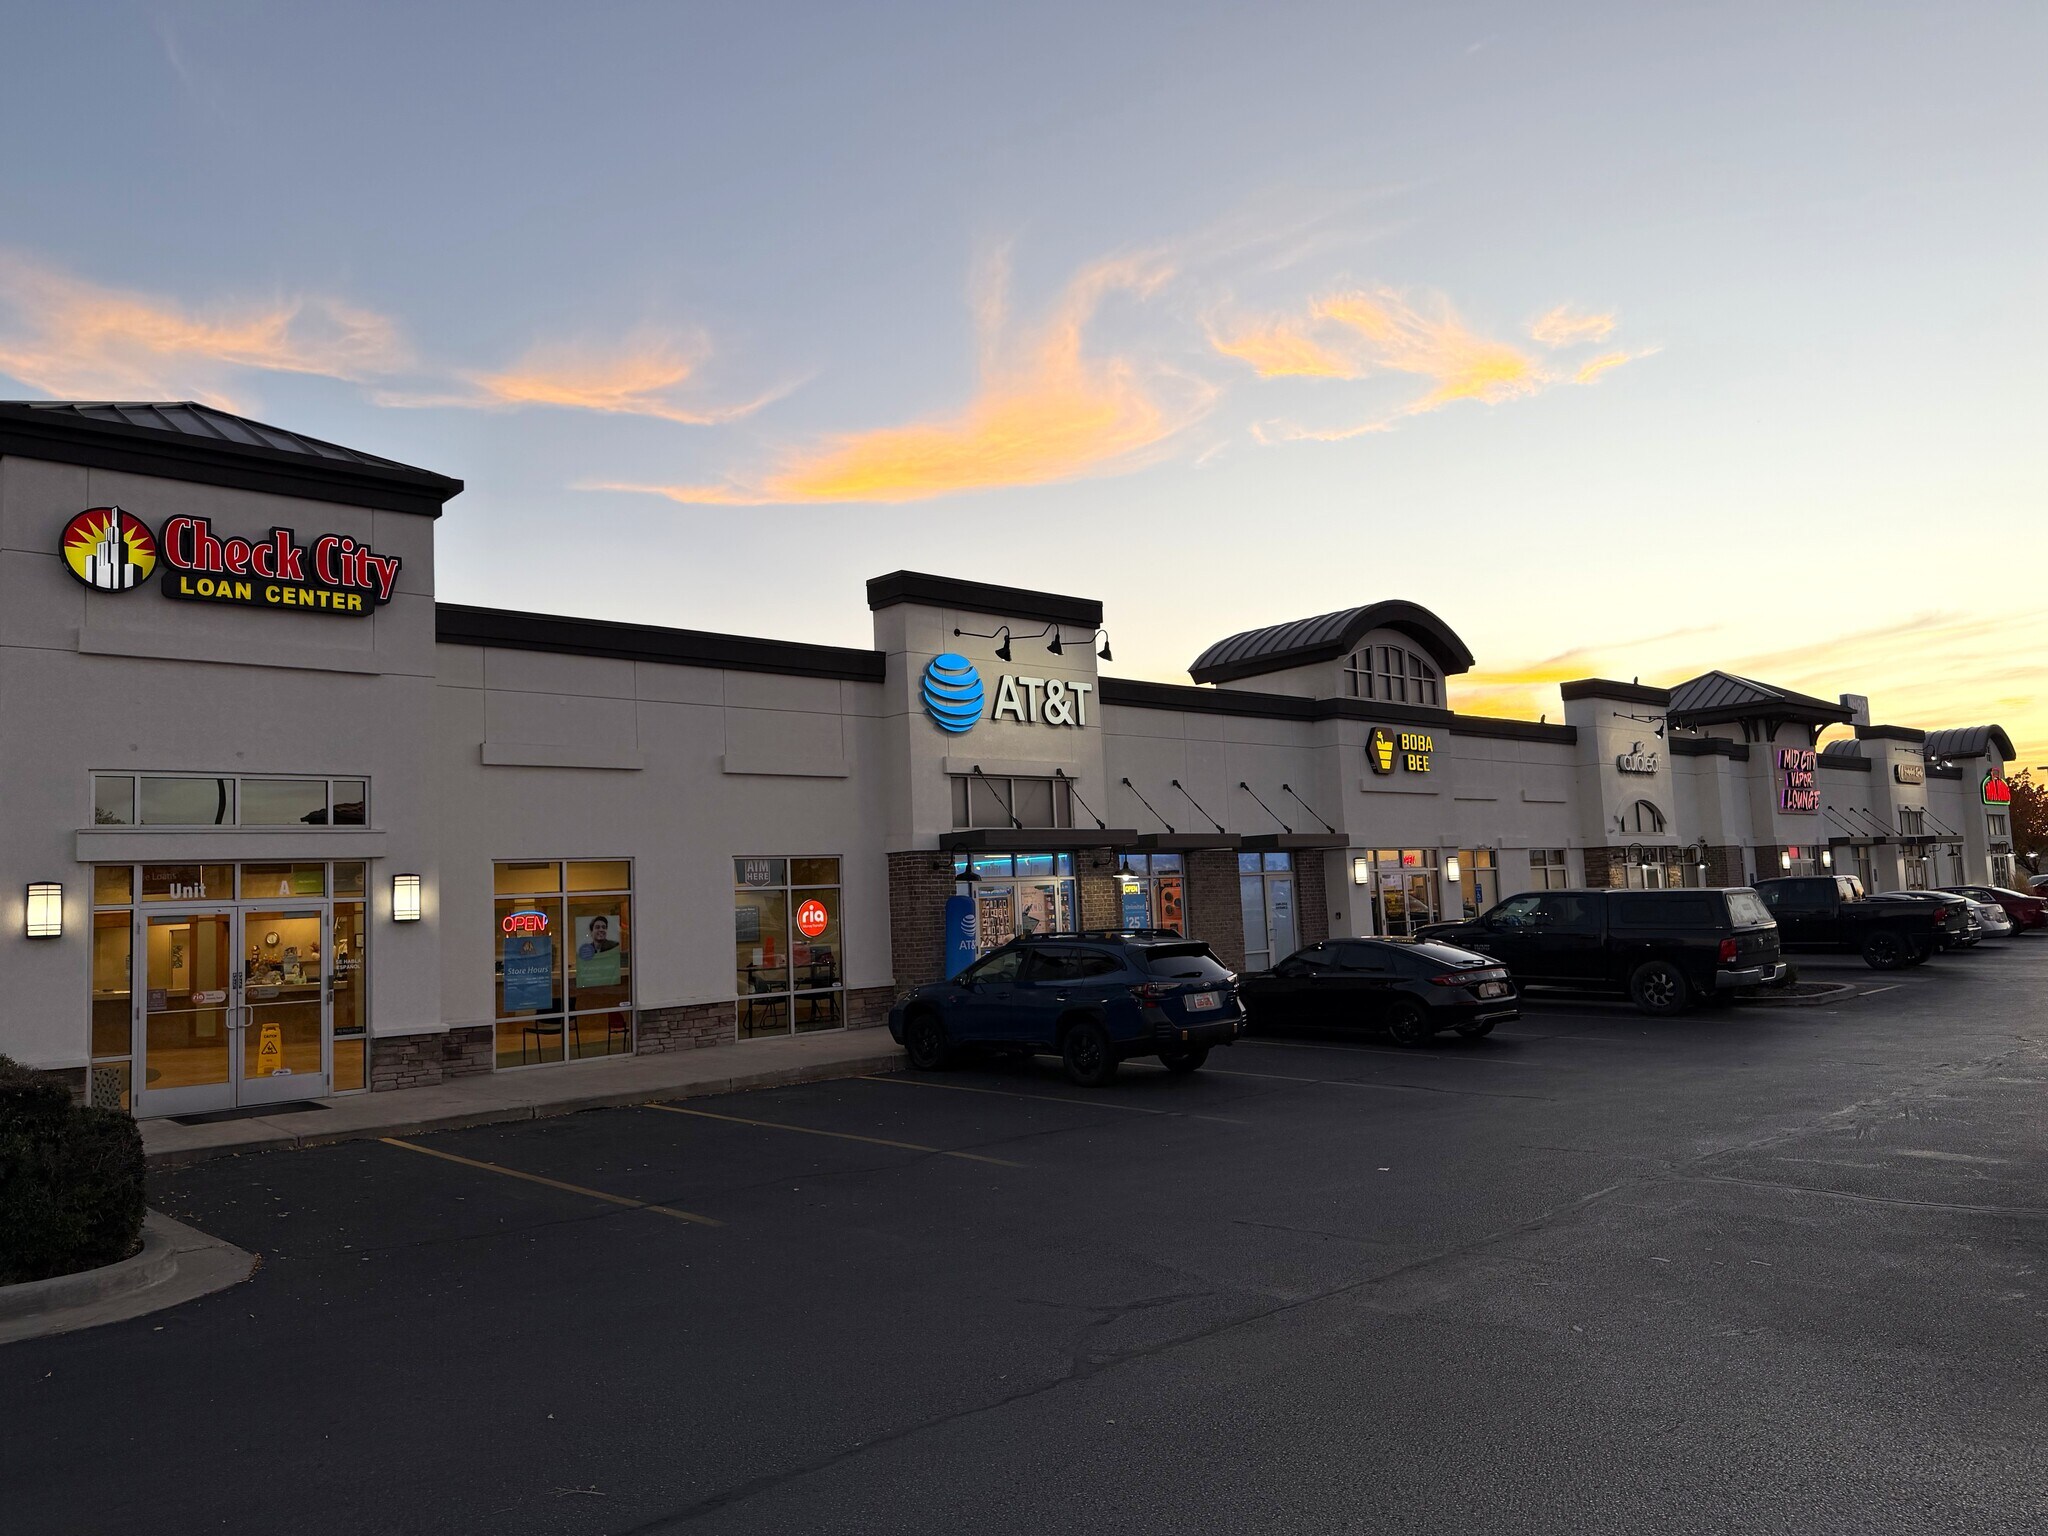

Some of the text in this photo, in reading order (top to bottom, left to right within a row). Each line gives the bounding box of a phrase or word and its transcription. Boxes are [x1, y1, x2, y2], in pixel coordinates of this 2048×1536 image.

[165, 517, 399, 600] Check City
[180, 576, 362, 611] LOAN CENTER
[994, 674, 1092, 726] AT&T
[1401, 733, 1433, 752] BOBA
[1407, 754, 1430, 772] BEE
[1783, 749, 1817, 770] MID CITY
[1790, 771, 1812, 787] VAPOR
[1787, 789, 1820, 810] LOUNGE
[747, 859, 769, 872] ATM
[747, 873, 769, 881] HERE
[169, 880, 290, 899] Unit A
[802, 904, 825, 923] ria
[502, 915, 546, 932] OPEN
[507, 965, 549, 975] Store Hours
